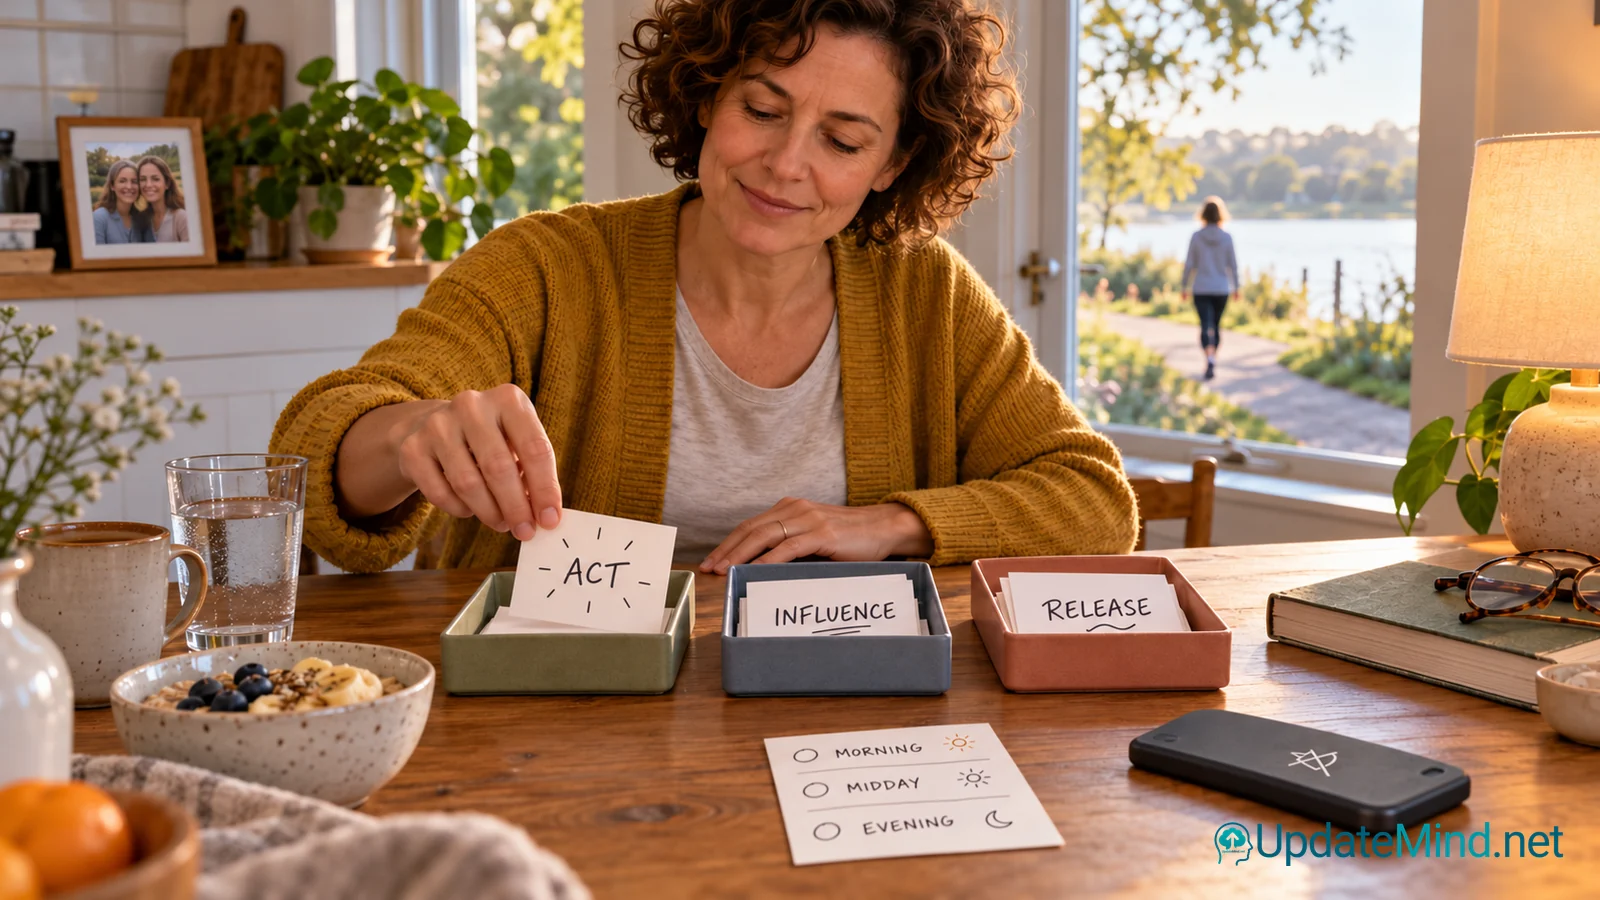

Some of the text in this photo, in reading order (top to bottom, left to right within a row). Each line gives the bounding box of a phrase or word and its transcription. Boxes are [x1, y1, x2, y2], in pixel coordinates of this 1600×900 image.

[563, 557, 631, 589] ACT
[774, 601, 897, 627] INFLUENCE
[1041, 597, 1153, 622] RELEASE
[835, 742, 924, 760] MORNING
[846, 777, 920, 794] MIDDAY
[862, 814, 955, 836] EVENING
